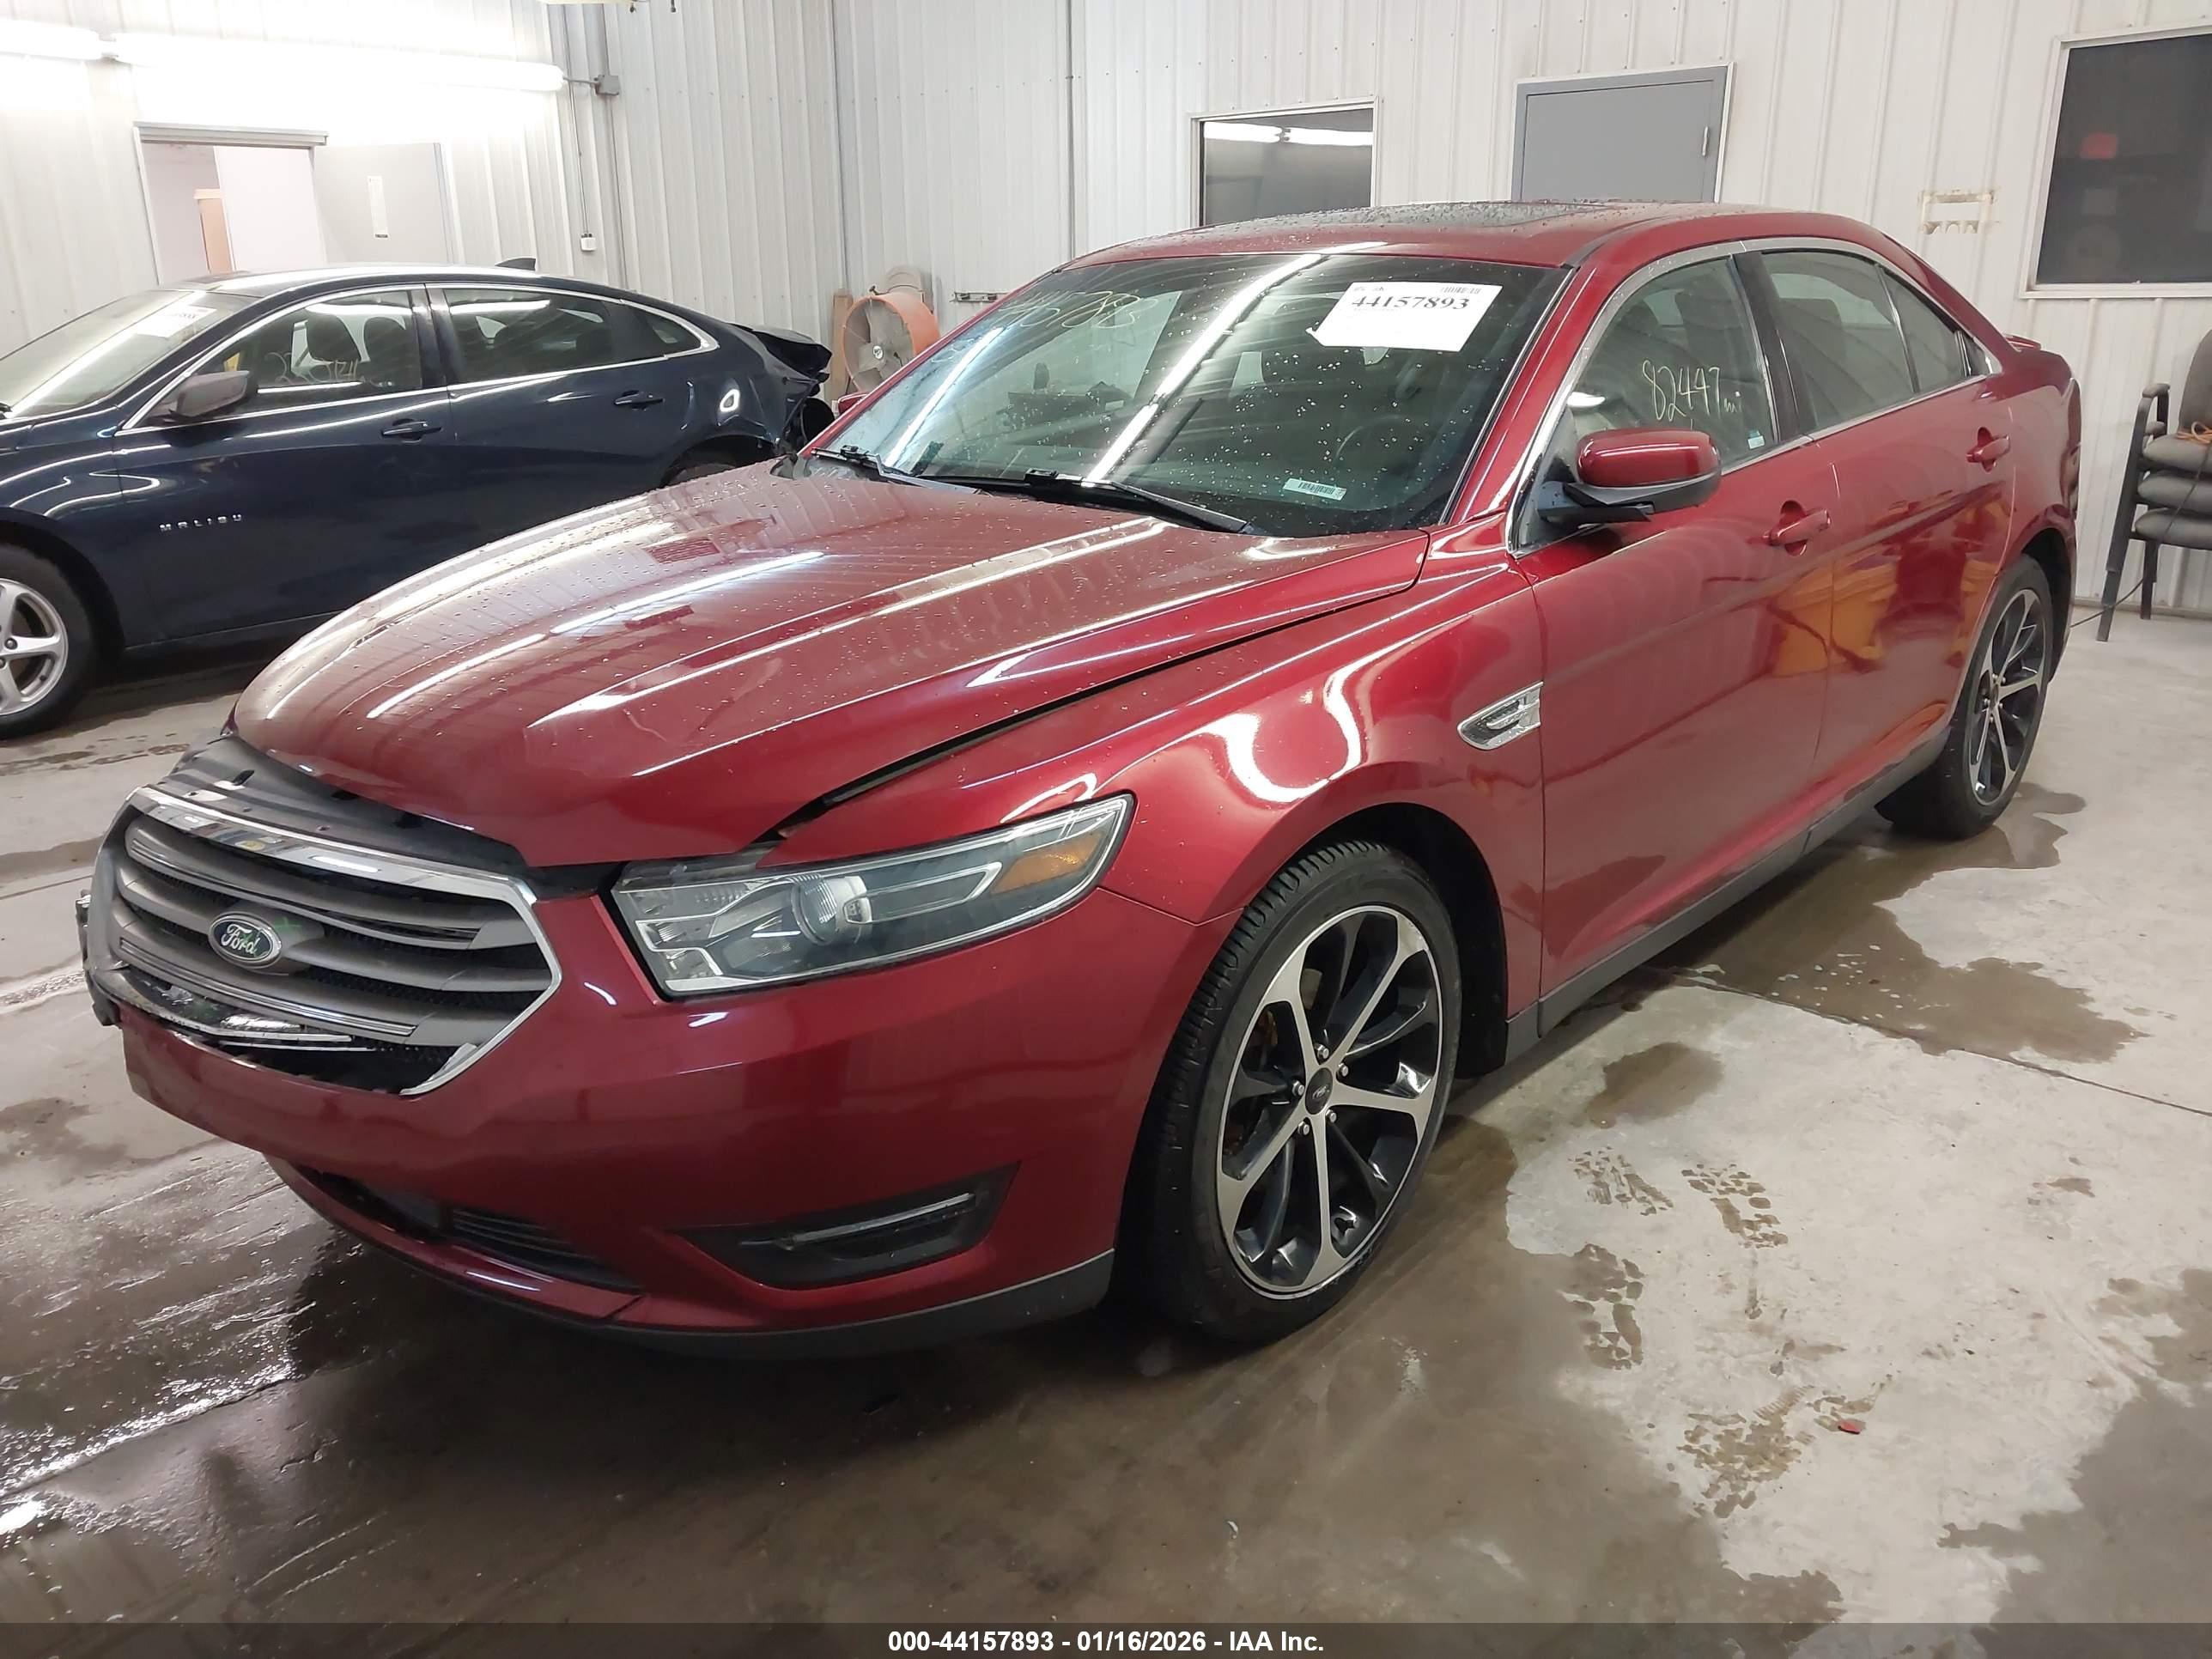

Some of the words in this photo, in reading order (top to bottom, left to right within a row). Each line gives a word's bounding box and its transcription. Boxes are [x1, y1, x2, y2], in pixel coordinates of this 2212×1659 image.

[1351, 295, 1470, 310] 44157893
[159, 514, 241, 532] MALIBU
[221, 923, 261, 956] Ford
